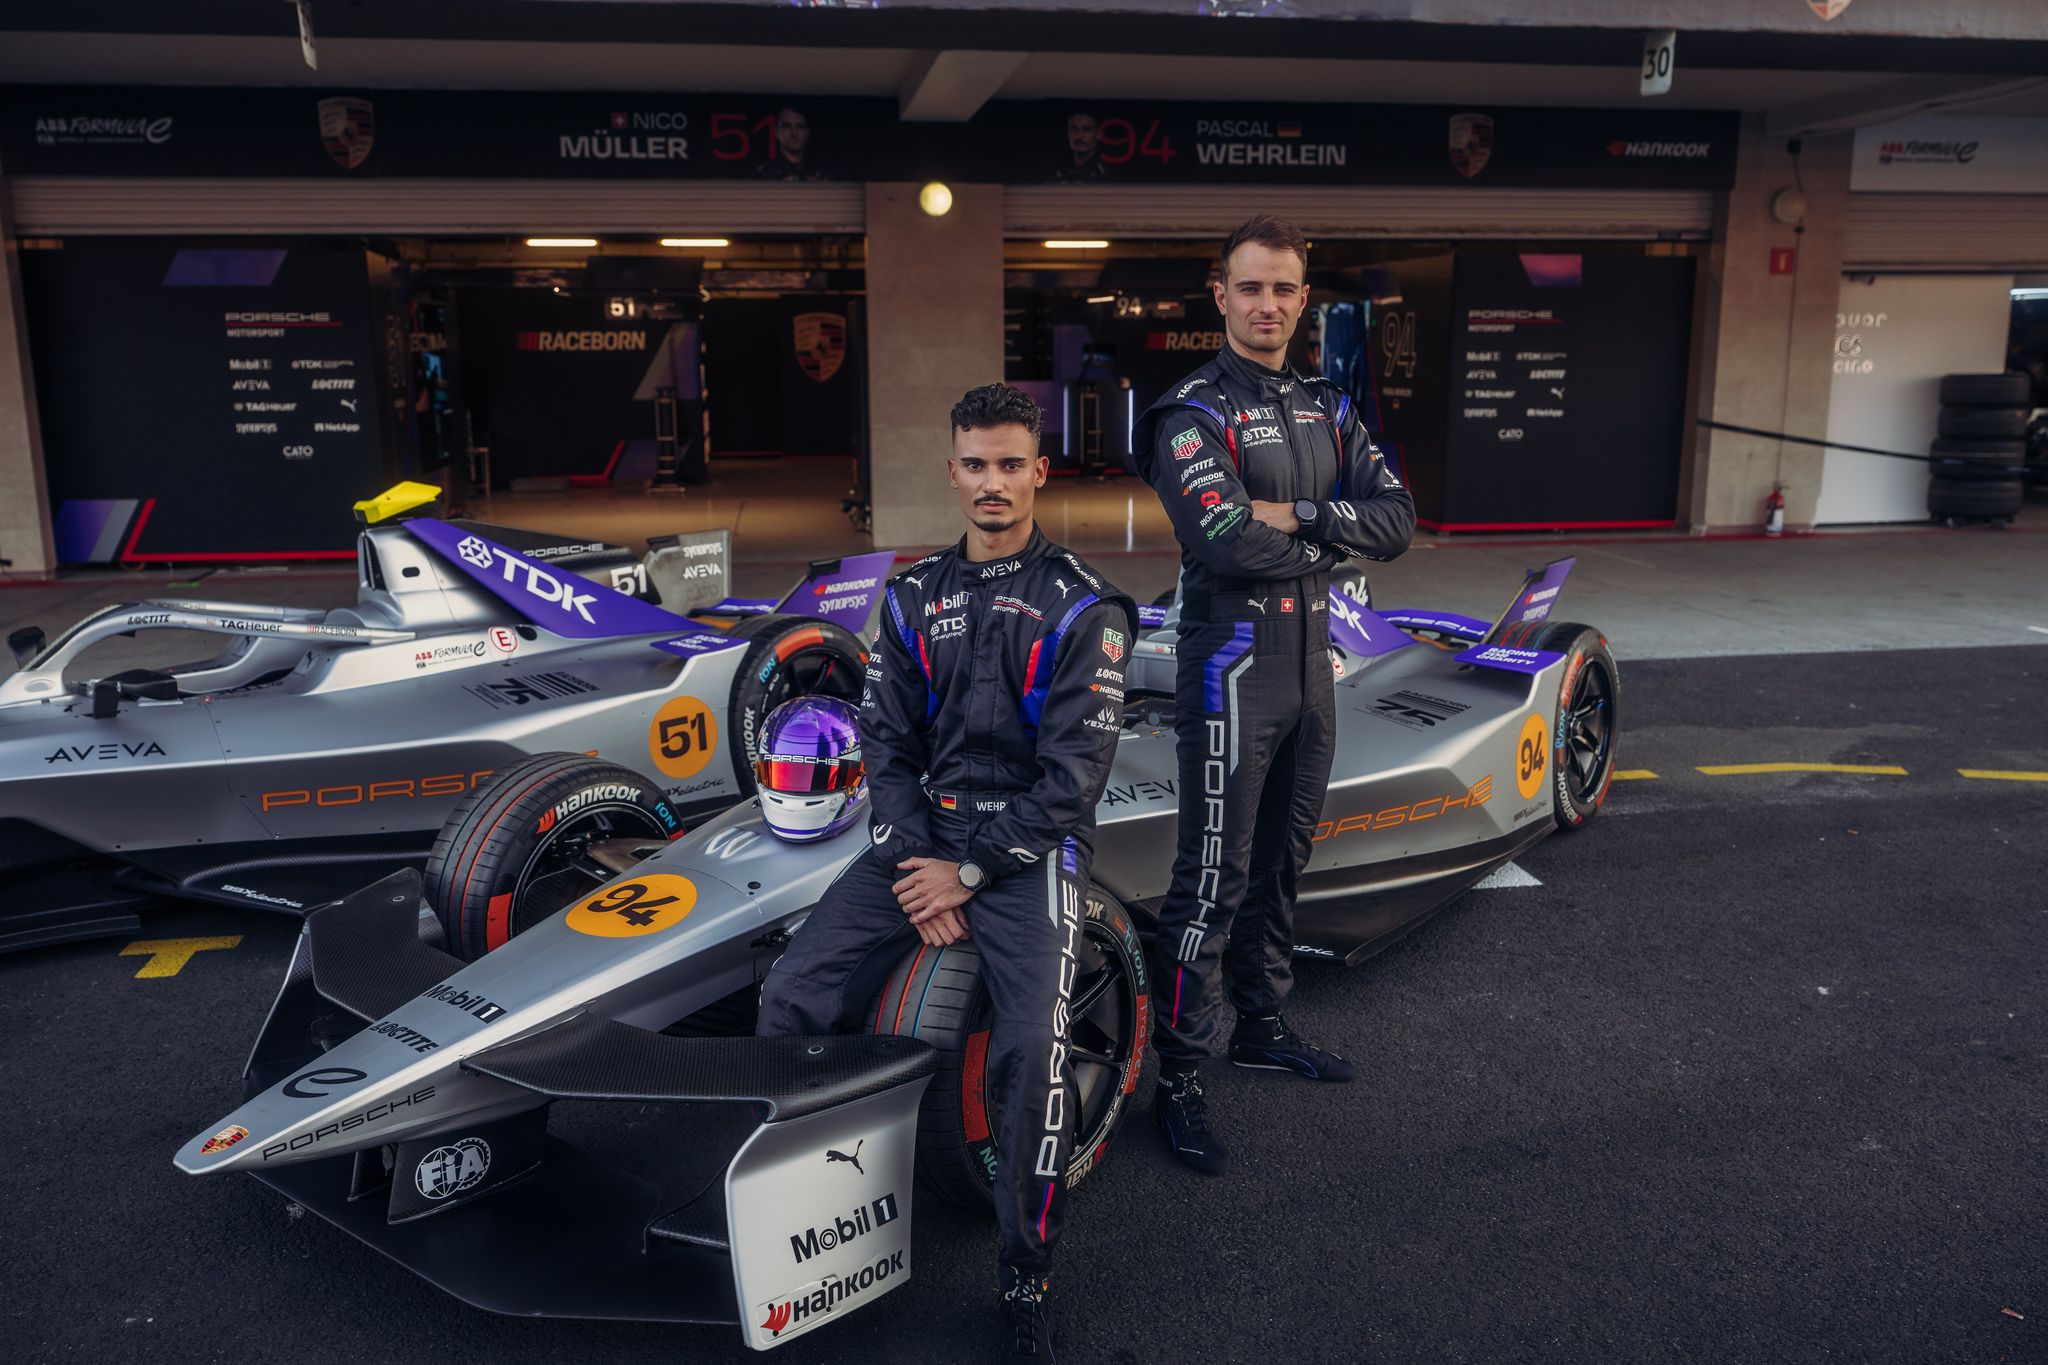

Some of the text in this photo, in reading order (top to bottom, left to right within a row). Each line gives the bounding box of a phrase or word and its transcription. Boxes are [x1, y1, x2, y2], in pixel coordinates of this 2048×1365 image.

[1644, 47, 1670, 79] 30
[633, 112, 688, 130] NICO
[1197, 120, 1274, 138] PASCAL
[560, 129, 688, 159] MÜLLER
[711, 113, 778, 160] 51
[1100, 118, 1177, 166] 94
[1196, 142, 1346, 166] WEHRLEIN
[225, 312, 330, 322] PORSCHE
[1468, 310, 1553, 319] PORSCHE
[226, 328, 285, 337] MOTORSPORT
[539, 331, 646, 351] RACEBORN
[1382, 312, 1417, 379] 94
[232, 379, 271, 390] AVEVA
[311, 379, 357, 390] LOCTITE
[1172, 429, 1200, 448] TAG
[1249, 426, 1282, 440] TDK
[282, 445, 314, 458] CATO
[1174, 440, 1202, 459] HEUER
[1199, 511, 1216, 529] RIGA
[522, 543, 604, 557] PORSCHE
[683, 563, 722, 580] AVEVA
[980, 560, 1022, 579] AVEVA
[492, 547, 598, 625] TDK
[610, 563, 648, 597] 51
[925, 593, 961, 617] Mobil
[993, 595, 1043, 617] PORSCHE
[127, 613, 171, 626] LOCTITE
[220, 619, 283, 633] TAGHeuer
[415, 651, 433, 661] ABB
[433, 643, 473, 659] FORMULA
[1487, 647, 1539, 658] RACING
[658, 712, 708, 759] 51
[44, 742, 166, 763] AVEVA
[763, 754, 840, 768] PORSCHE
[1519, 730, 1545, 782] 94
[1177, 719, 1226, 961] PORSCHE
[587, 884, 681, 927] 94
[422, 984, 487, 1011] Mobil
[369, 1021, 439, 1054] LOCTITE
[1035, 879, 1079, 1178] PORSCHE
[263, 1086, 436, 1161] PORSCHE
[790, 1205, 872, 1264] Mobil
